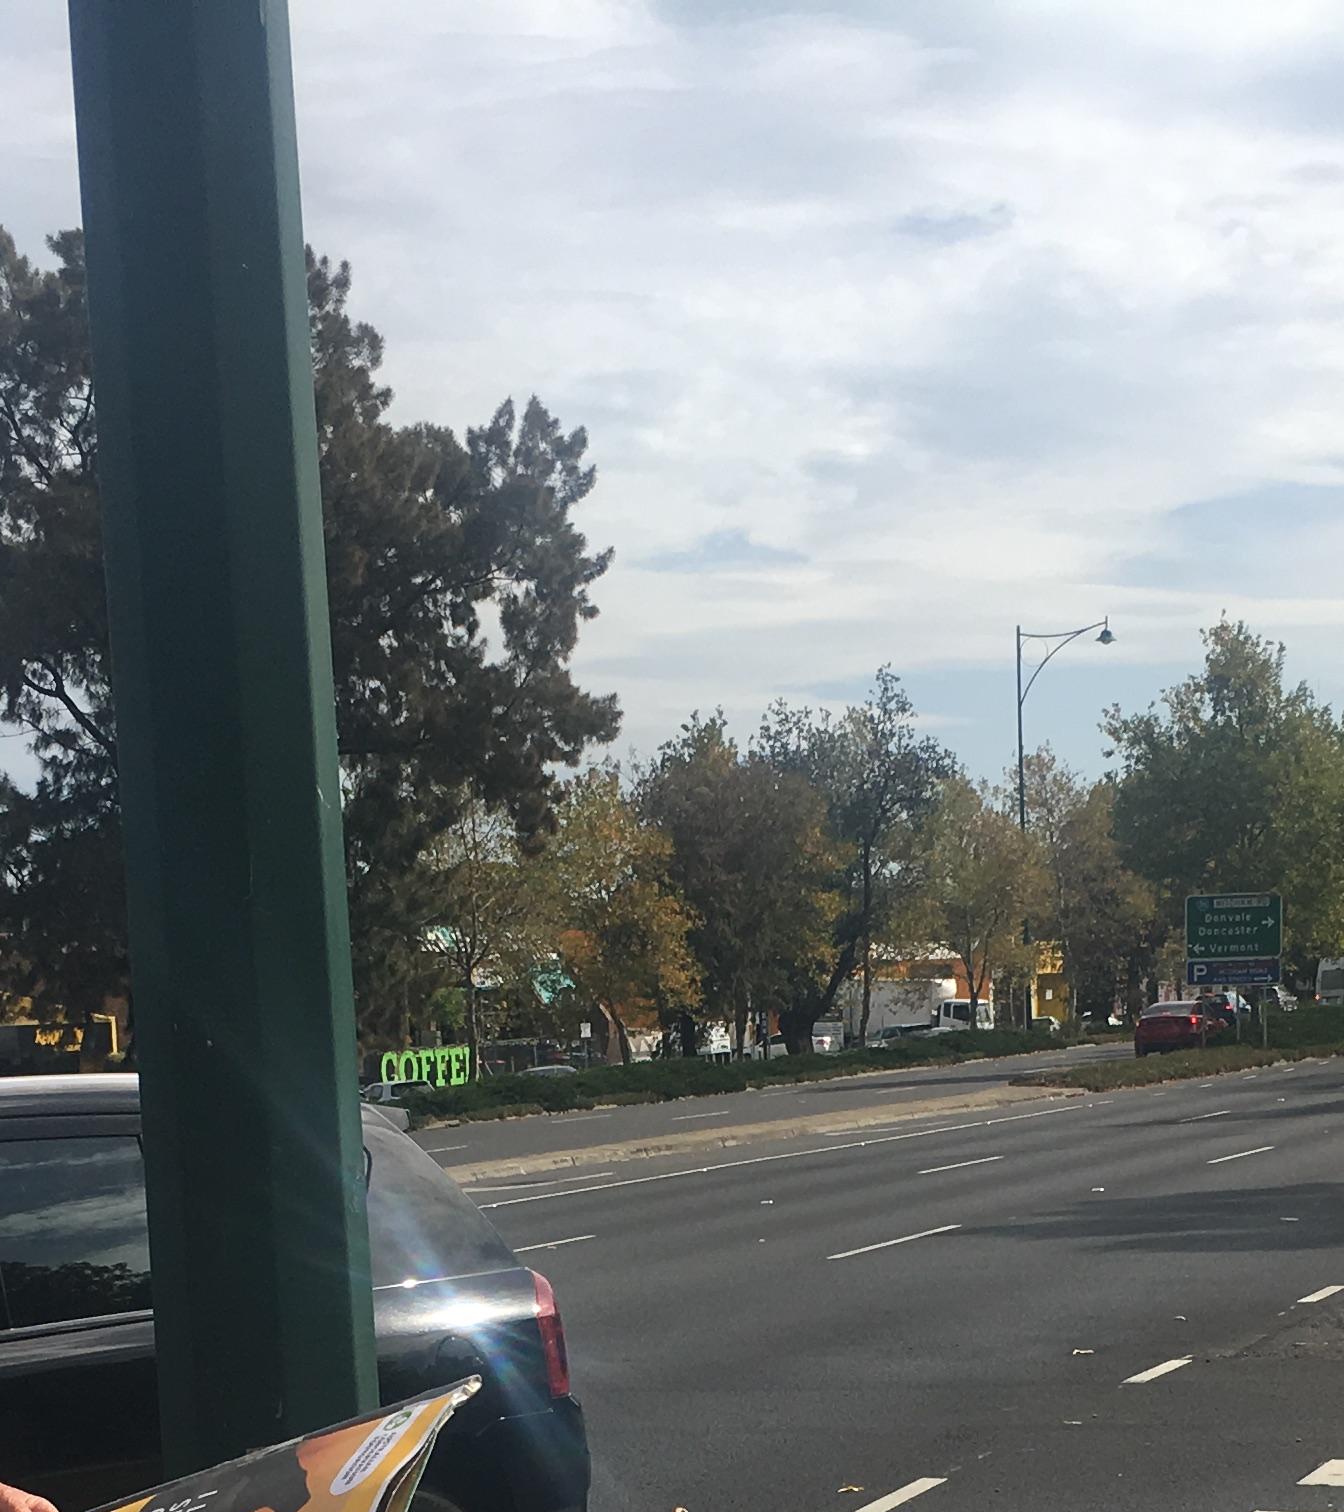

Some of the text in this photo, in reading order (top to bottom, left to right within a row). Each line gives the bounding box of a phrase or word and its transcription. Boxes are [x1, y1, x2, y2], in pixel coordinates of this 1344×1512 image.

[1204, 912, 1251, 924] Donvale
[1198, 926, 1258, 937] Doncaster
[1209, 944, 1259, 953] Vermont
[197, 1489, 219, 1500] I
